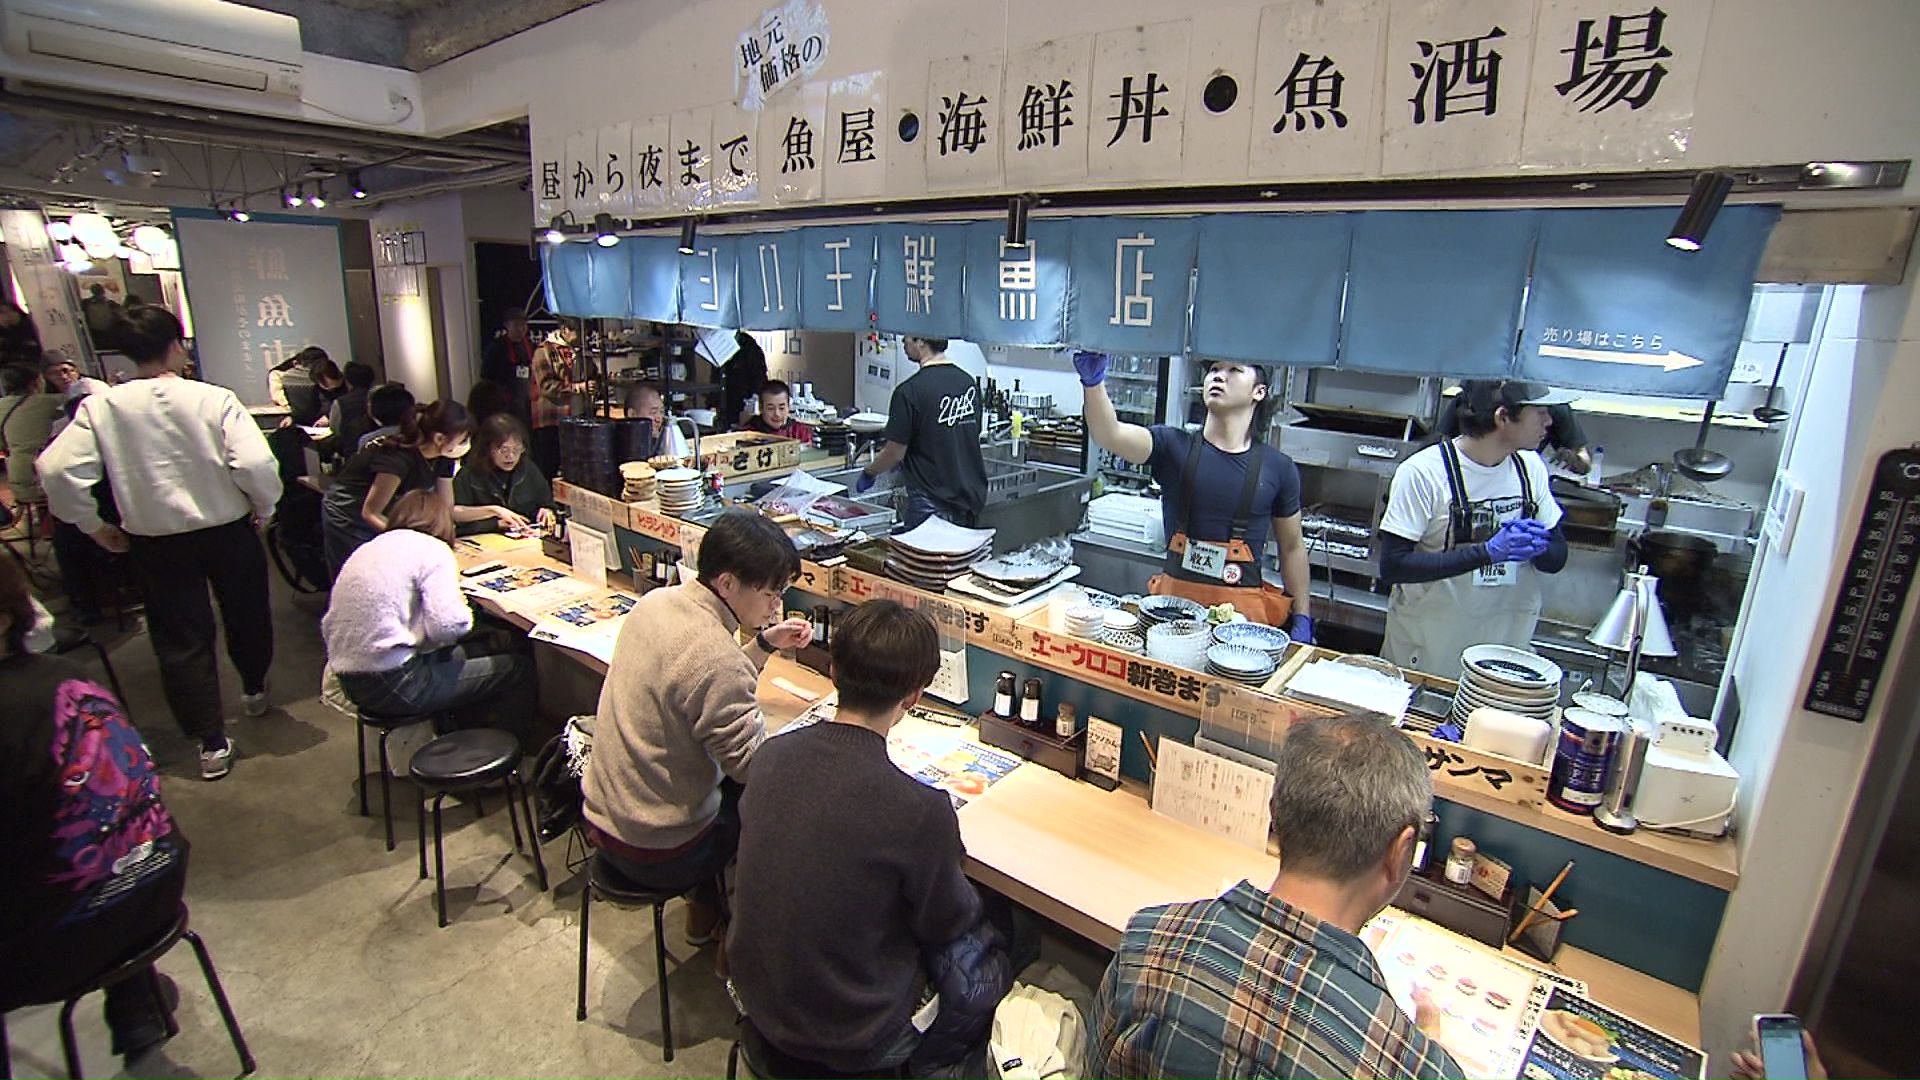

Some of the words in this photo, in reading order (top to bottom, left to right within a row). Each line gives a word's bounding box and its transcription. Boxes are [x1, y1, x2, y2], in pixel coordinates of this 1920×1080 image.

[740, 16, 784, 68] 地元
[760, 36, 822, 92] 価格の
[1543, 327, 1663, 350] 売り場はこちら
[733, 447, 773, 471] さけ
[1424, 746, 1512, 790] サンマ
